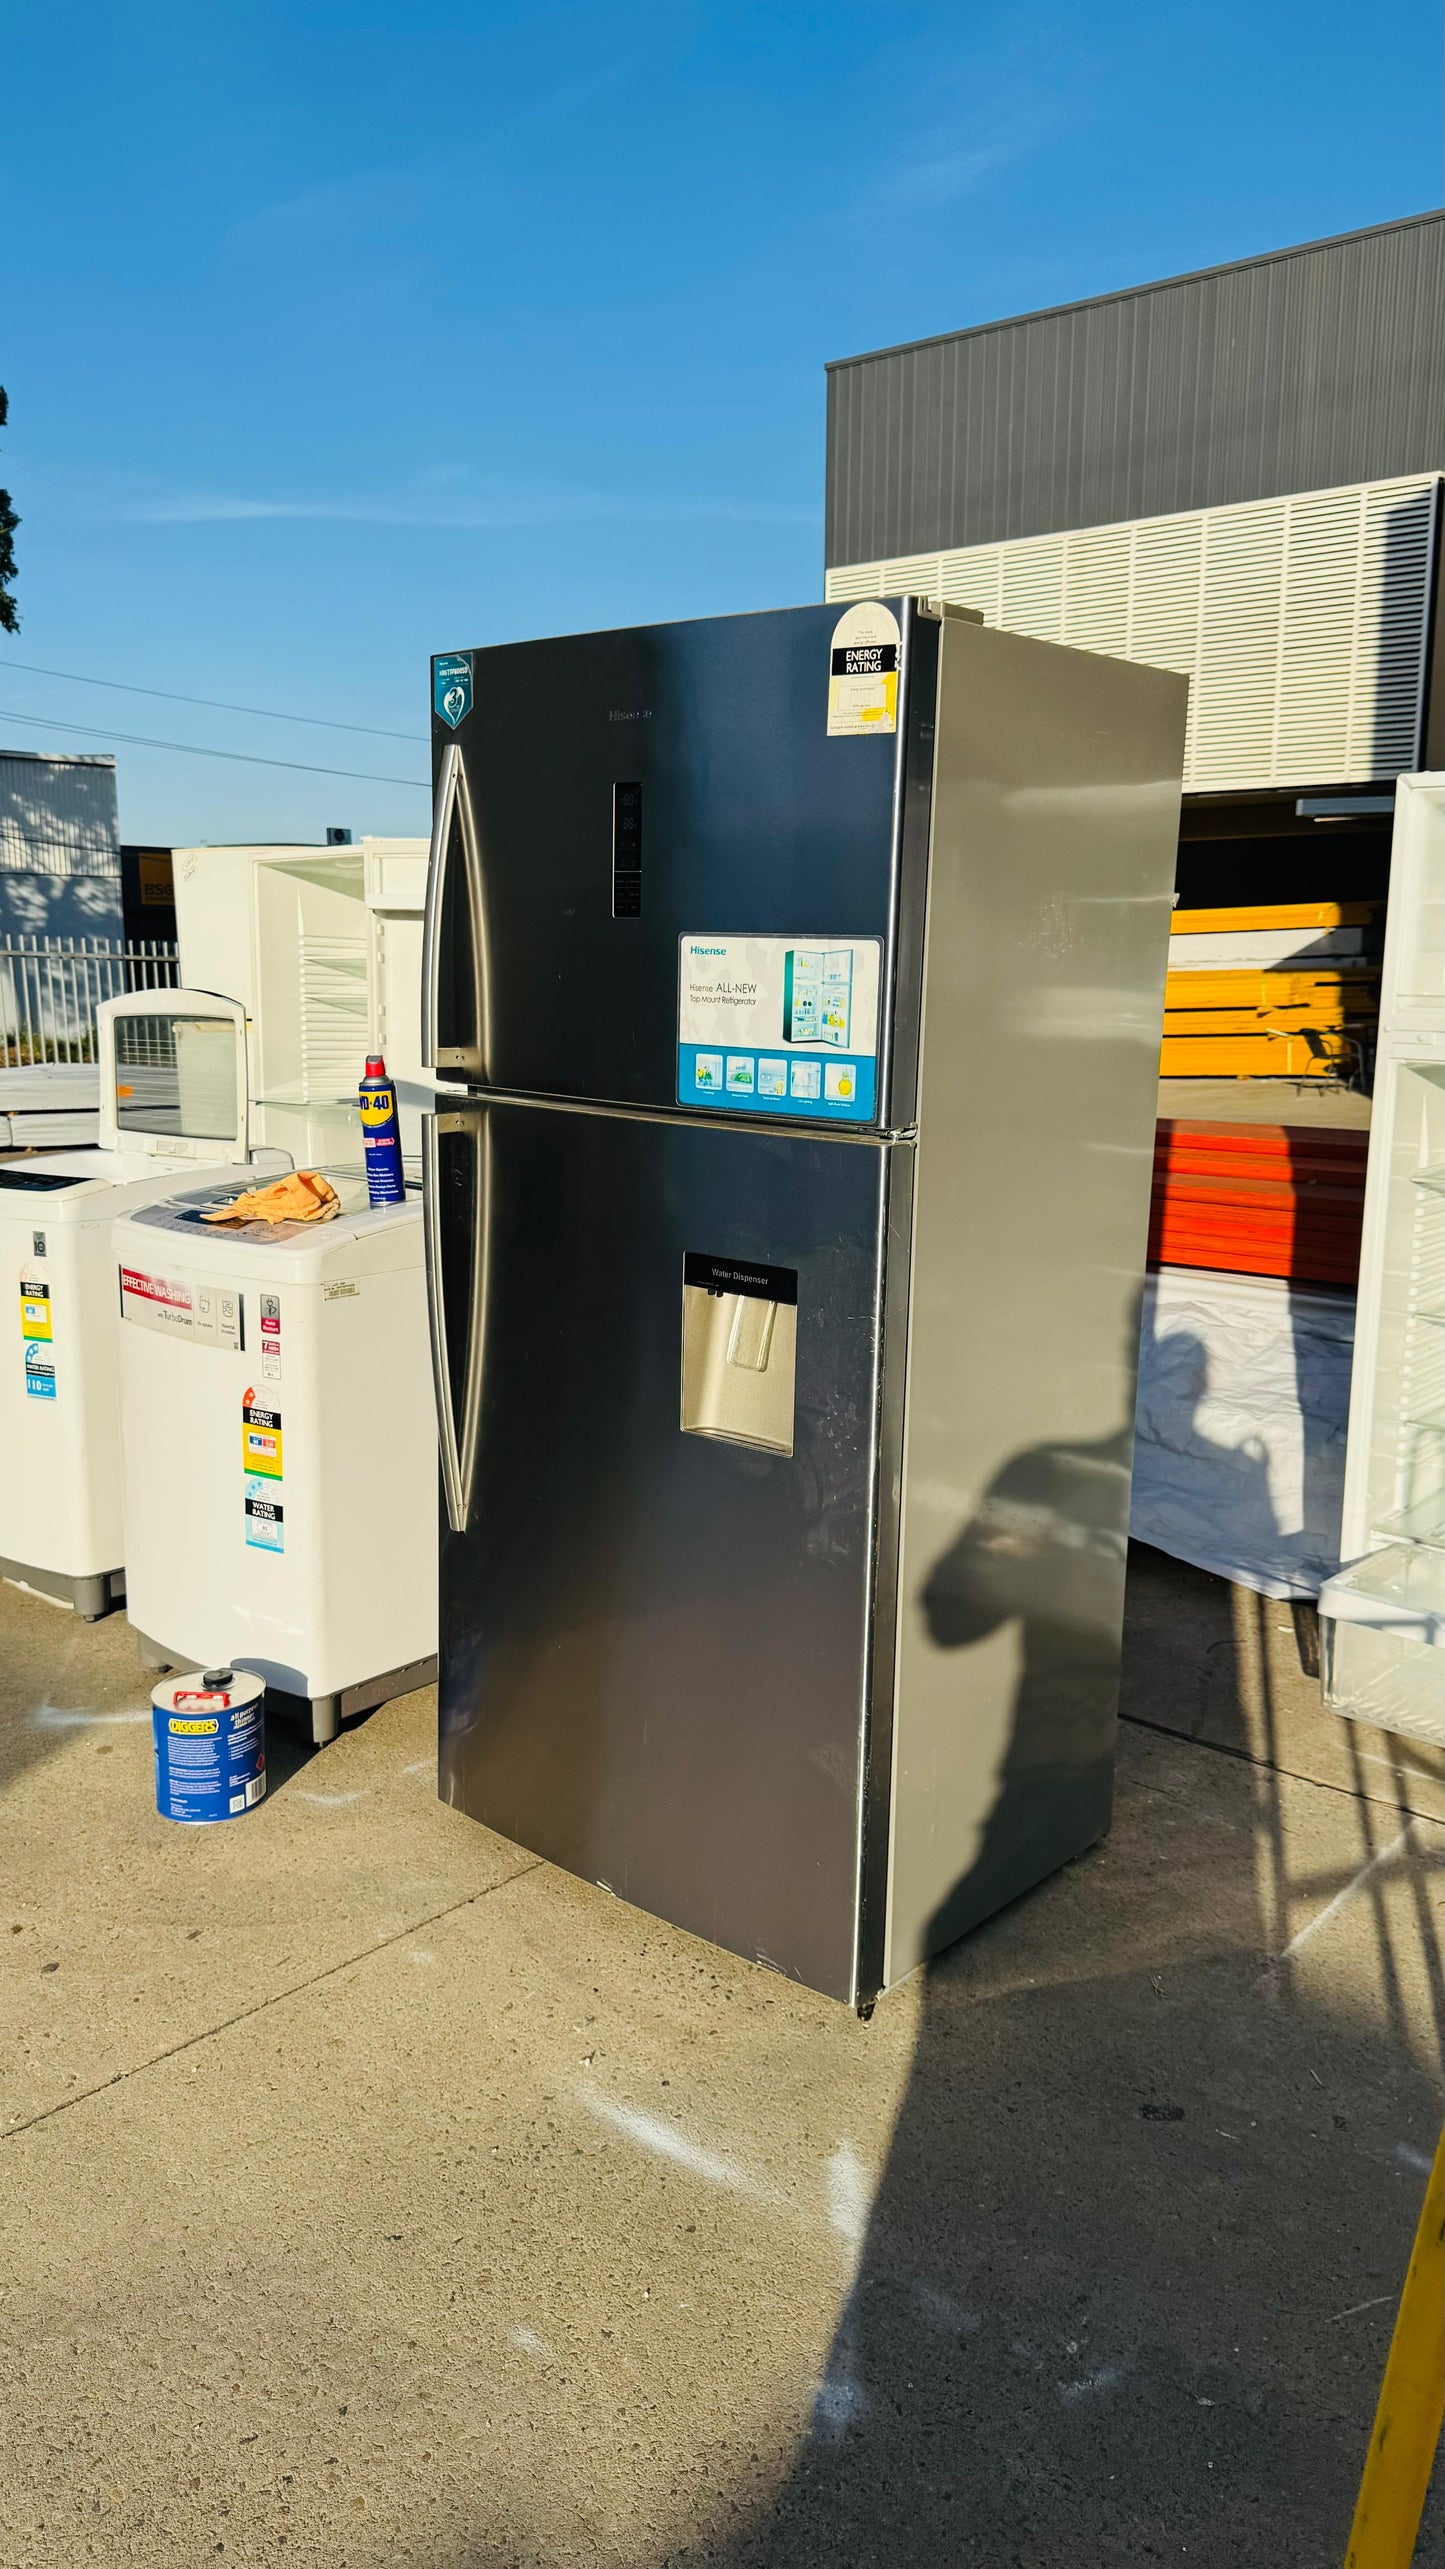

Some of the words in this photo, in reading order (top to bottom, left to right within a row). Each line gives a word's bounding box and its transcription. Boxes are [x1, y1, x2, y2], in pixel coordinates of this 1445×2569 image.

[846, 648, 883, 662] ENERGY
[846, 661, 882, 673] RATING
[690, 946, 727, 956] Hisense
[690, 983, 714, 993] Hisense
[716, 982, 758, 994] ALL-NEW
[690, 994, 701, 1003] Top
[702, 995, 721, 1004] Mount
[711, 1268, 732, 1279] Water
[733, 1271, 769, 1285] Dispenser
[123, 1274, 155, 1296] EFFECTIVE
[155, 1282, 191, 1305] WASHING
[163, 1310, 193, 1325] TurboDrum
[27, 1378, 42, 1391] 110
[249, 1409, 274, 1420] ENERGY
[249, 1416, 274, 1427] RATING
[252, 1501, 275, 1513] WATER
[252, 1508, 276, 1520] RATING
[170, 1719, 217, 1734] DIGGERS
